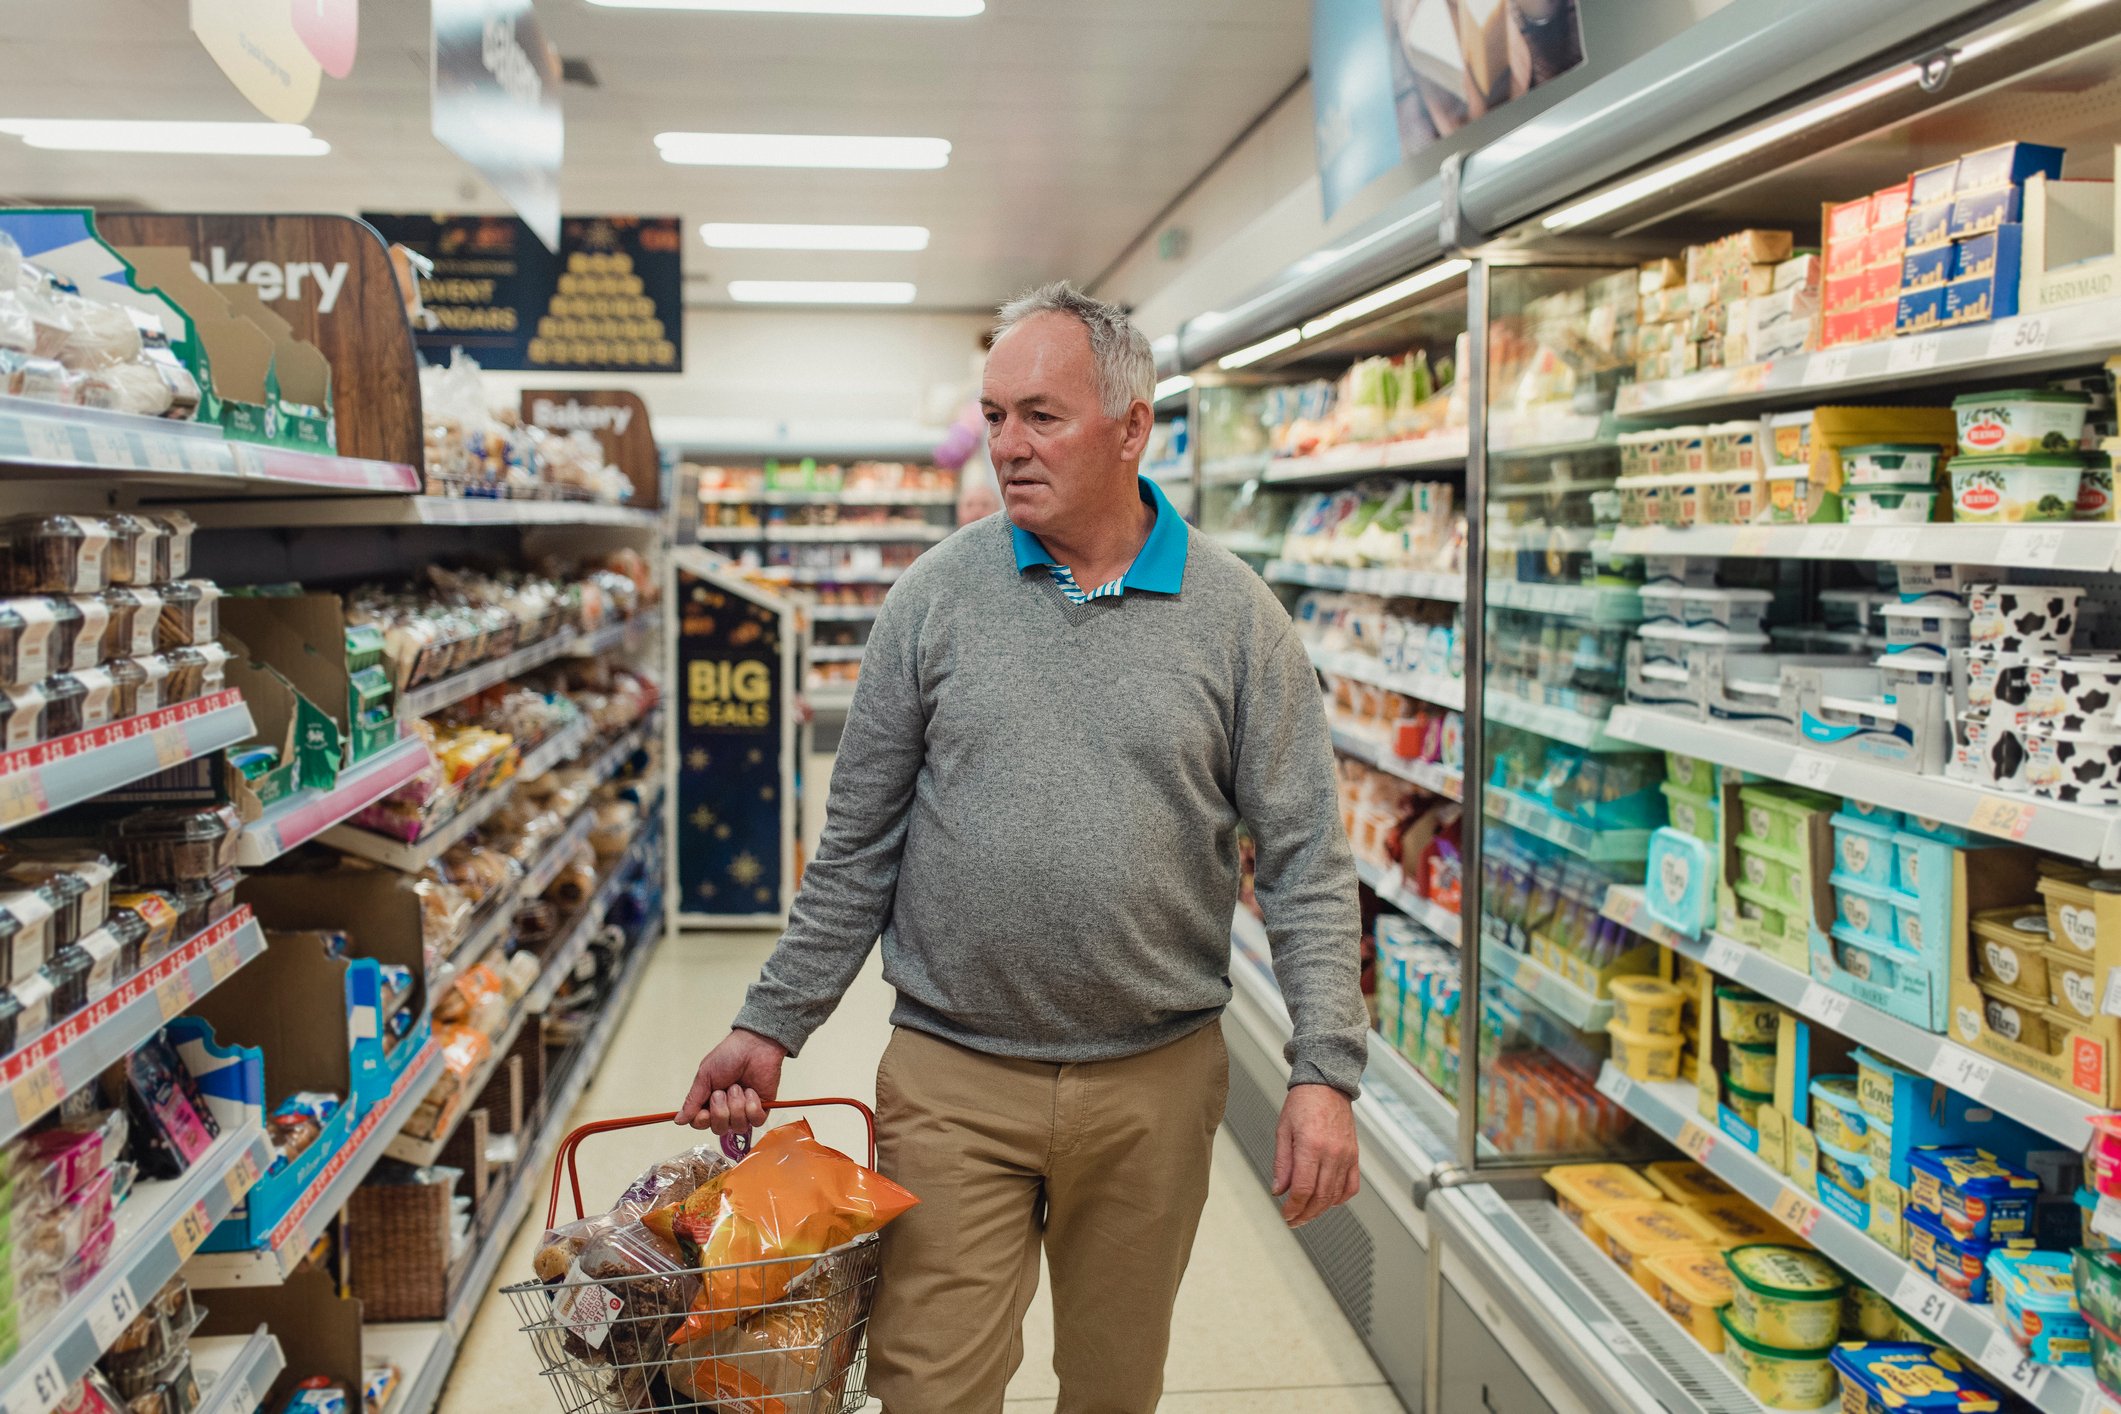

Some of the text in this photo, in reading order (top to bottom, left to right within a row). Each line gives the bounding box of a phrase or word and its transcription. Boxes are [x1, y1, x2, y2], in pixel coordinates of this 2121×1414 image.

[2039, 273, 2113, 306] KERRYMAID
[532, 398, 633, 436] Bakery
[688, 659, 770, 701] BIG
[688, 702, 769, 727] DEALS
[2063, 911, 2095, 938] Flora
[1988, 947, 2016, 973] Flora
[1754, 1010, 1778, 1029] Clo
[1988, 1006, 2017, 1033] Flora
[1862, 1076, 1893, 1106] Clove
[110, 1287, 133, 1322] £1
[1920, 1294, 1947, 1323] £1
[34, 1365, 59, 1404] £1
[2012, 1357, 2041, 1389] £1
